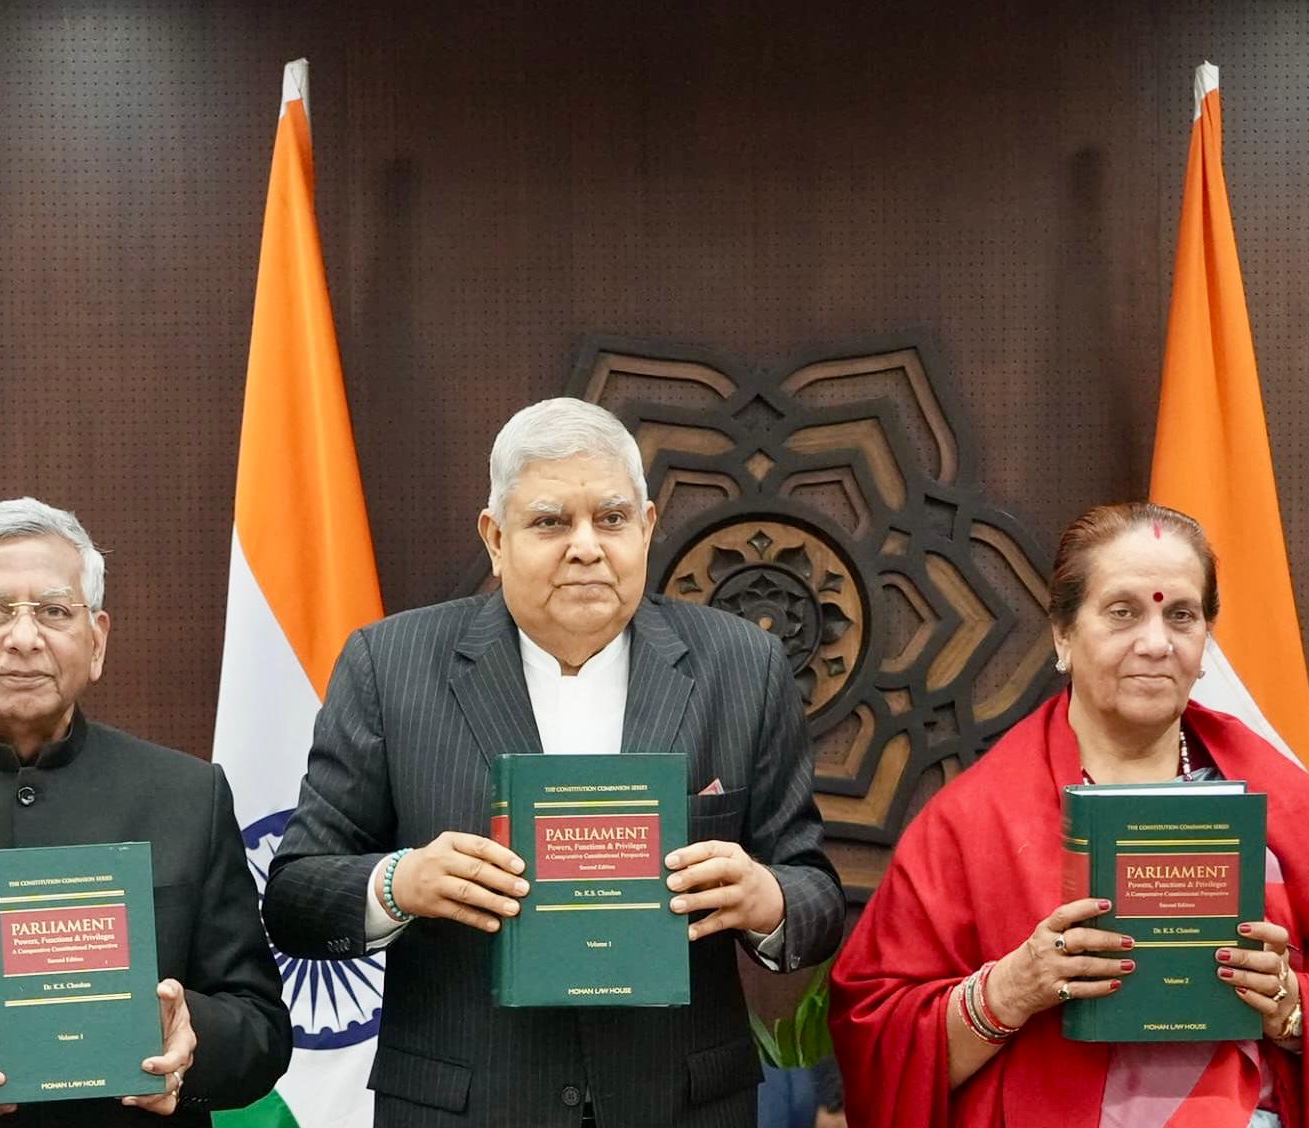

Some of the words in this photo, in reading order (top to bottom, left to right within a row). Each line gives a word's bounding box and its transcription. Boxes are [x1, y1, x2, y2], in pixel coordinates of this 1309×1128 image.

[546, 827, 649, 841] PARLIAMENT
[616, 842, 647, 851] Privileges
[1127, 865, 1229, 879] PARLIAMENT
[1195, 881, 1226, 889] Privileges
[11, 917, 116, 936] PARLIAMENT
[14, 938, 40, 946] Powers,
[41, 936, 72, 944] Functions
[83, 933, 115, 943] Privileges
[41, 1082, 67, 1090] MOHAN
[69, 1081, 82, 1089] LAW
[83, 1080, 106, 1088] HOUSE
